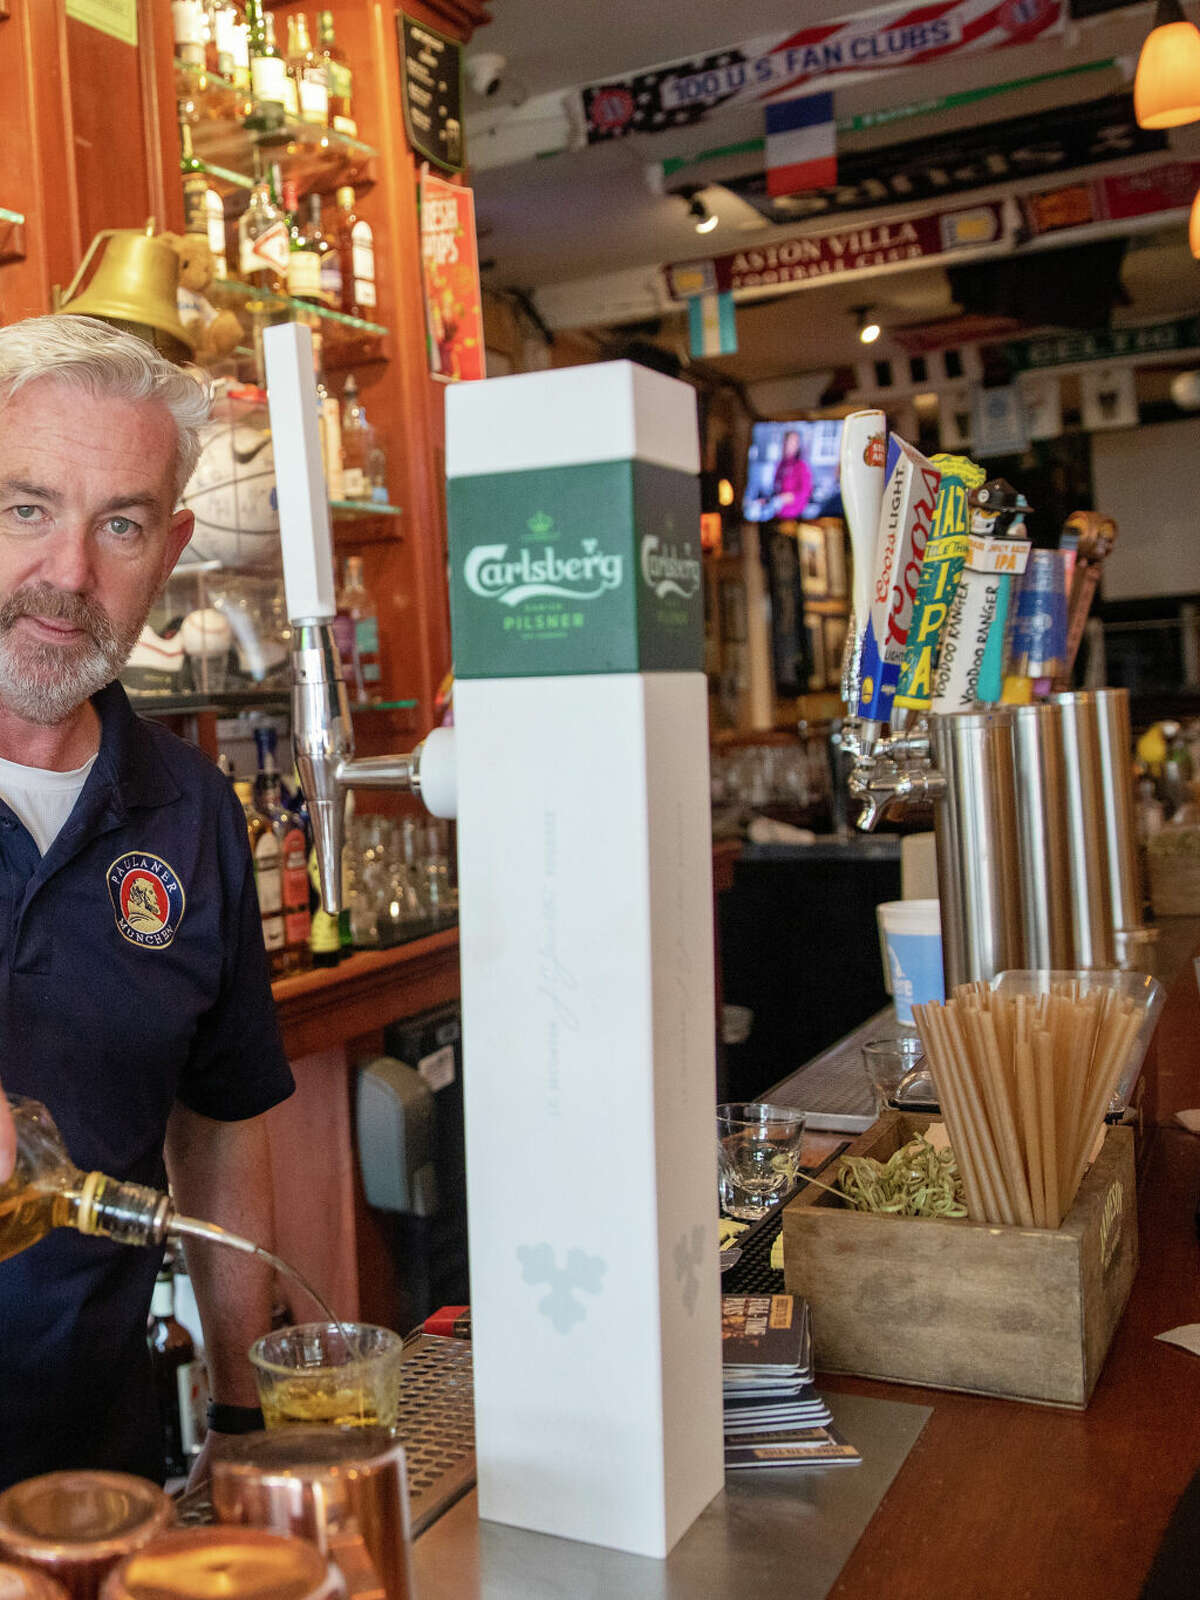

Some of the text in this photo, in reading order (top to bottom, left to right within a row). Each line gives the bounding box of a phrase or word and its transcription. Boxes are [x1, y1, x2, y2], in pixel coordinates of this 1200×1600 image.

[787, 44, 842, 71] FAN
[850, 19, 949, 58] CLUBS
[731, 222, 918, 272] ASTON VILLA
[889, 467, 904, 529] LIGHT
[463, 537, 626, 608] Carlsberg
[640, 534, 700, 599] Carlsberg
[885, 467, 942, 645] Coors
[994, 554, 1016, 571] IPA
[503, 612, 585, 631] PILSNER
[934, 582, 969, 699] VOODOO RANGER
[960, 585, 999, 706] VOODOO RANGER
[111, 856, 177, 893] PAULANER
